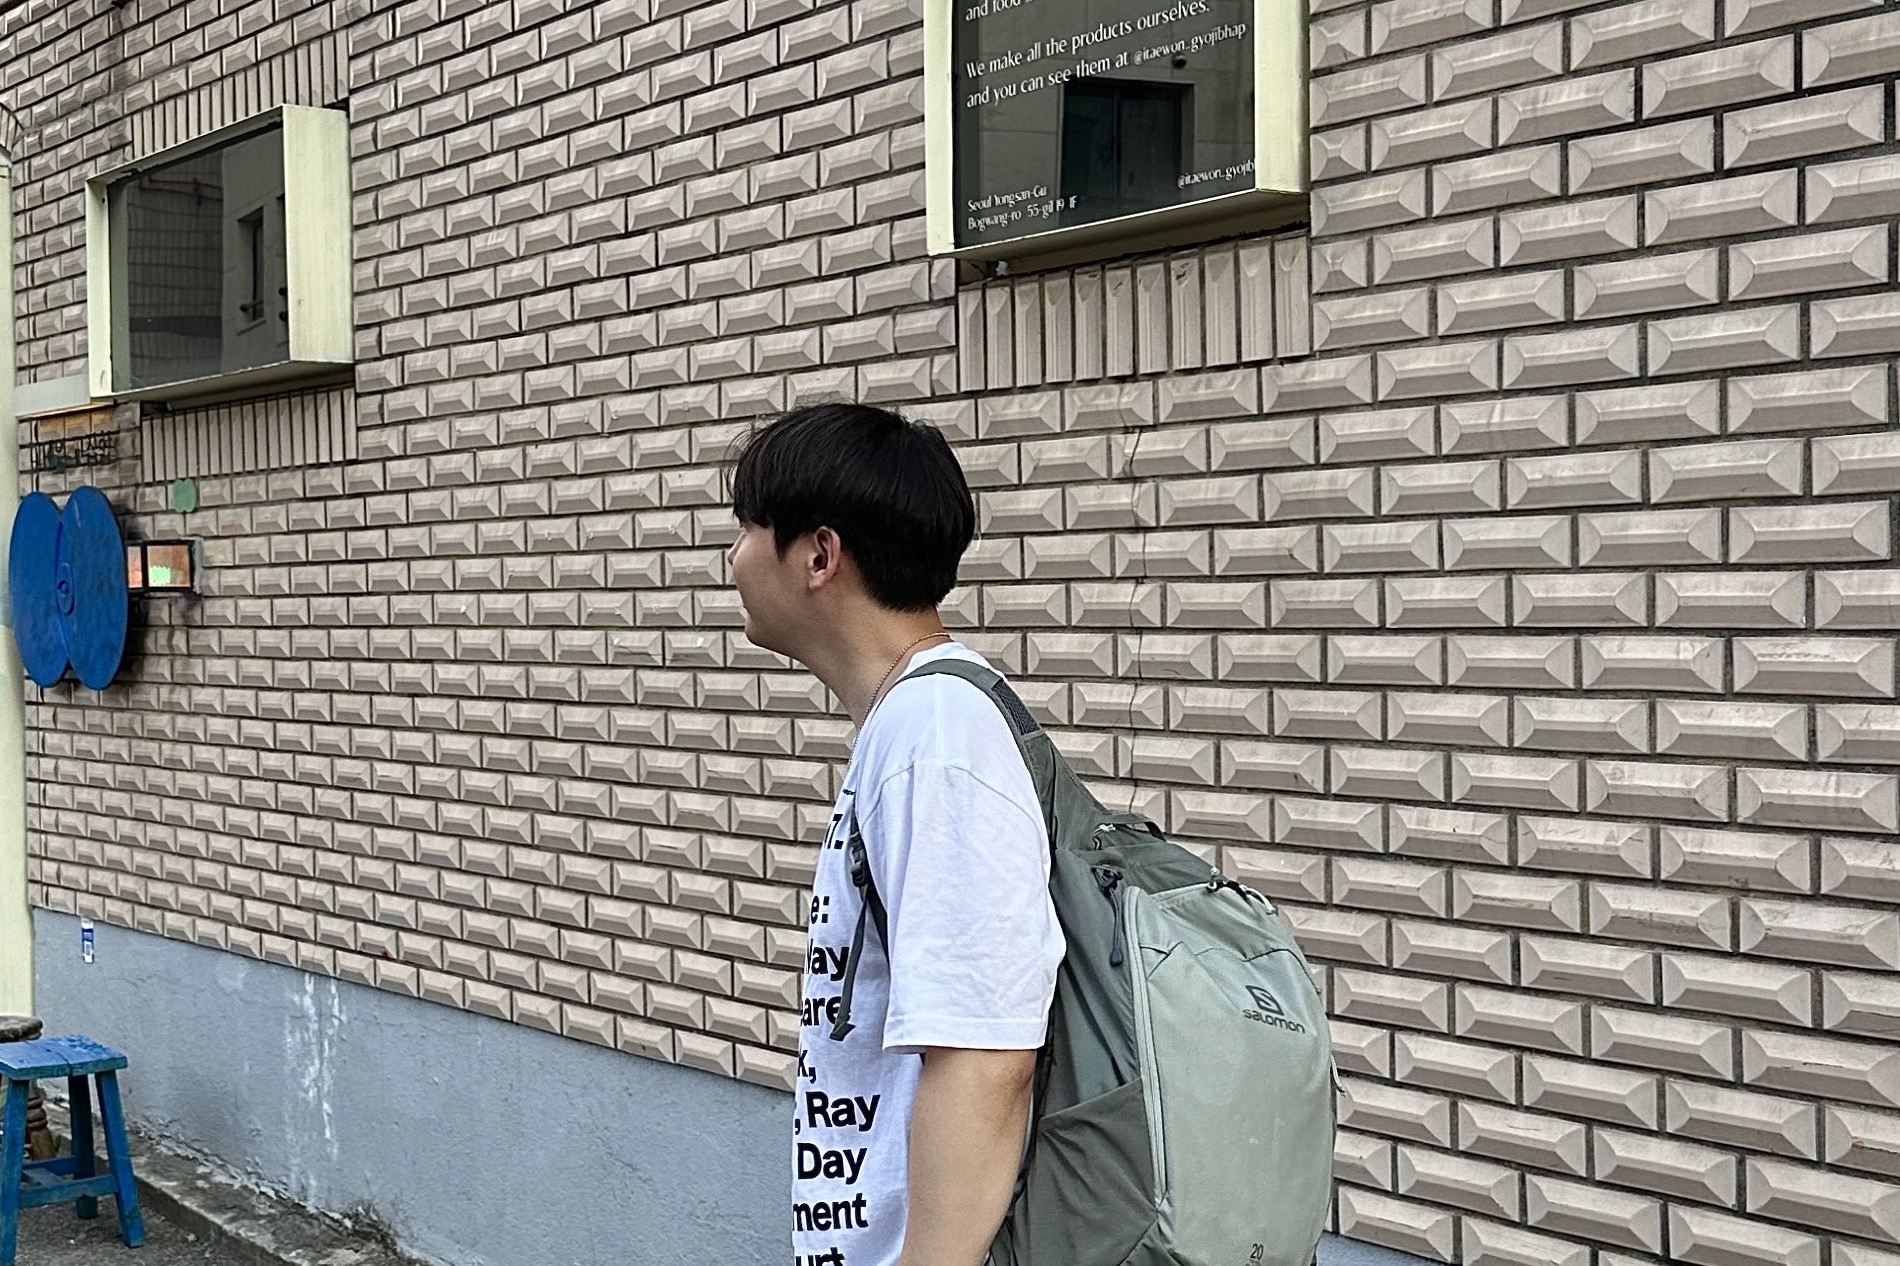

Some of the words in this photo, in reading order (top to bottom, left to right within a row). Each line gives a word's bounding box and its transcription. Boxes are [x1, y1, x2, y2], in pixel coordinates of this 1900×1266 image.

[965, 0, 989, 21] and
[966, 60, 985, 78] We
[989, 50, 1022, 73] make
[1026, 42, 1041, 62] all
[1046, 38, 1067, 56] the
[1071, 23, 1132, 55] products
[1136, 0, 1210, 30] ourselves.
[966, 85, 989, 108] and
[993, 83, 1017, 106] you
[1020, 76, 1044, 93] can
[1048, 68, 1071, 86] see
[1076, 57, 1111, 78] them
[1115, 51, 1129, 68] at
[1133, 23, 1247, 65] @itaewon_gyojibhap
[1176, 159, 1255, 189] @itaewon_gyojib
[967, 195, 992, 212] Seoul
[805, 1090, 881, 1132] Ray
[796, 1142, 868, 1185] Day
[1249, 1243, 1264, 1261] 20
